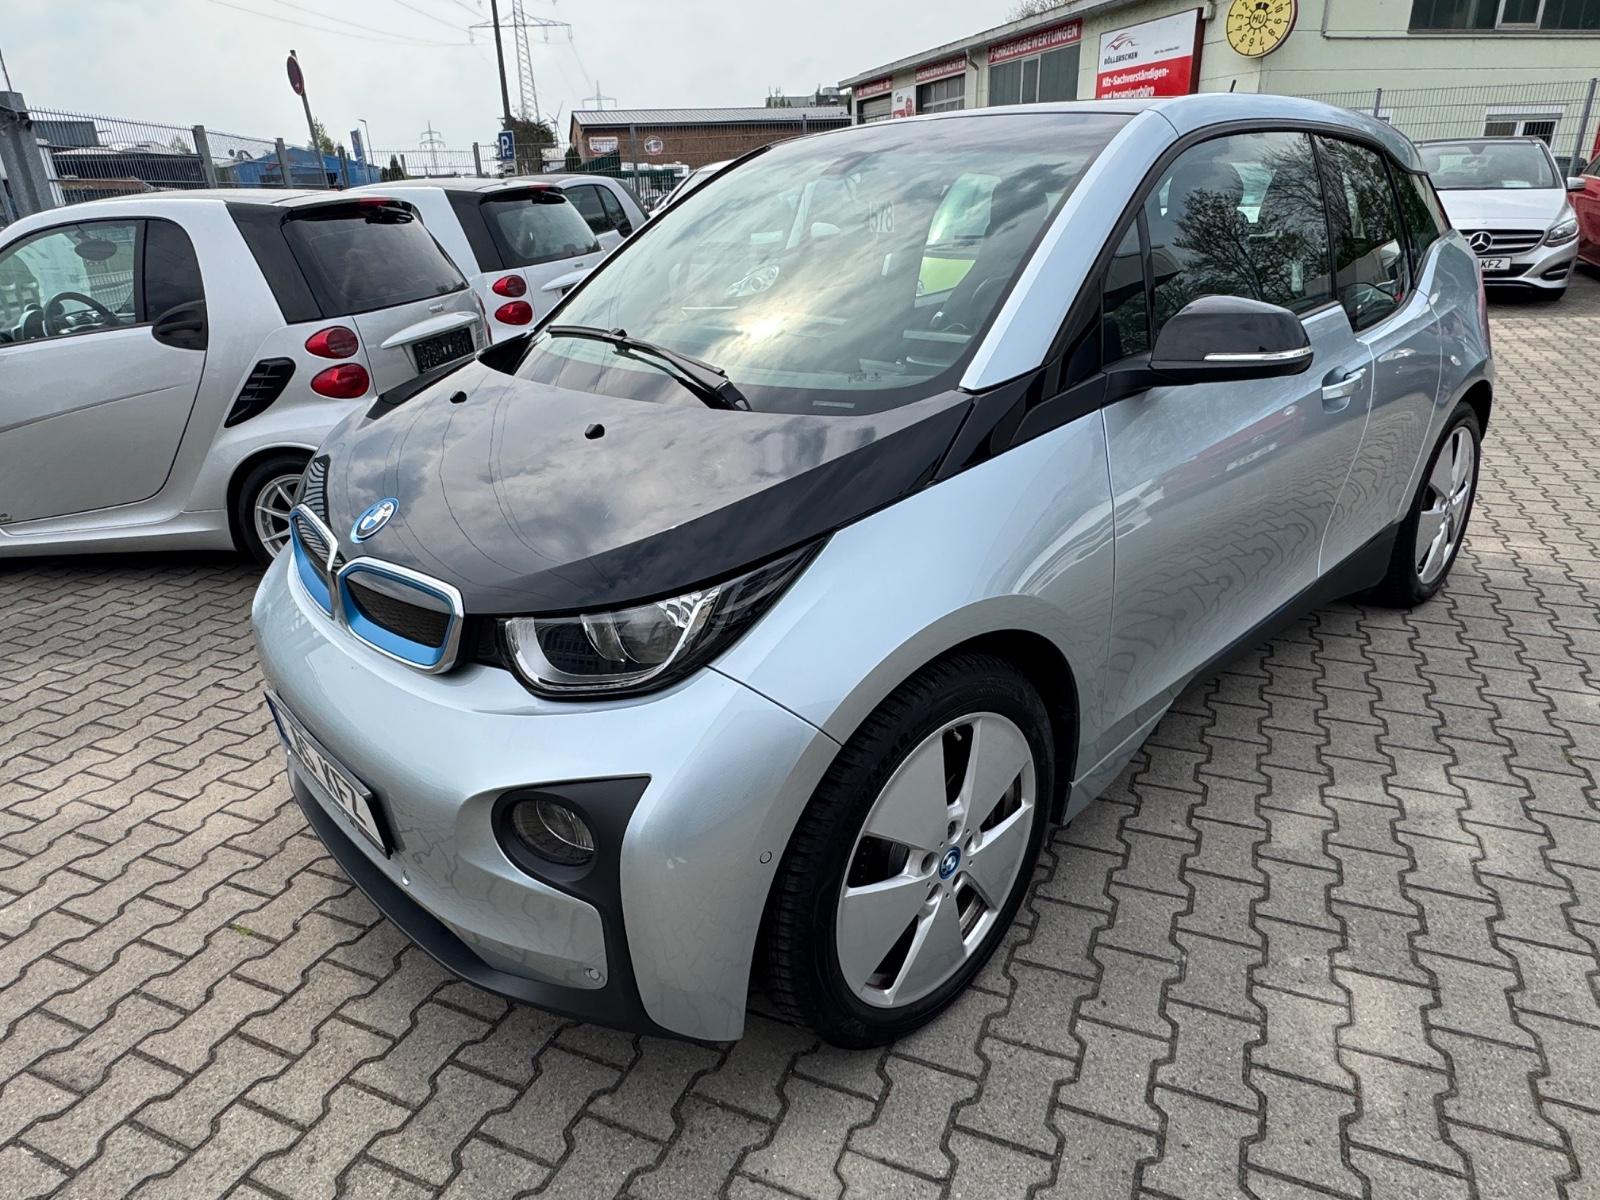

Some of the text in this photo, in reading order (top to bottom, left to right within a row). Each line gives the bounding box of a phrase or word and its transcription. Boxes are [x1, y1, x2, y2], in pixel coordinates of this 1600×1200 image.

[1252, 14, 1265, 24] HU
[989, 23, 1079, 61] FAHRZEUGBEWERTUNGEN
[1102, 67, 1170, 88] Kfz-Sachverständigen-
[1481, 259, 1503, 268] KFZ
